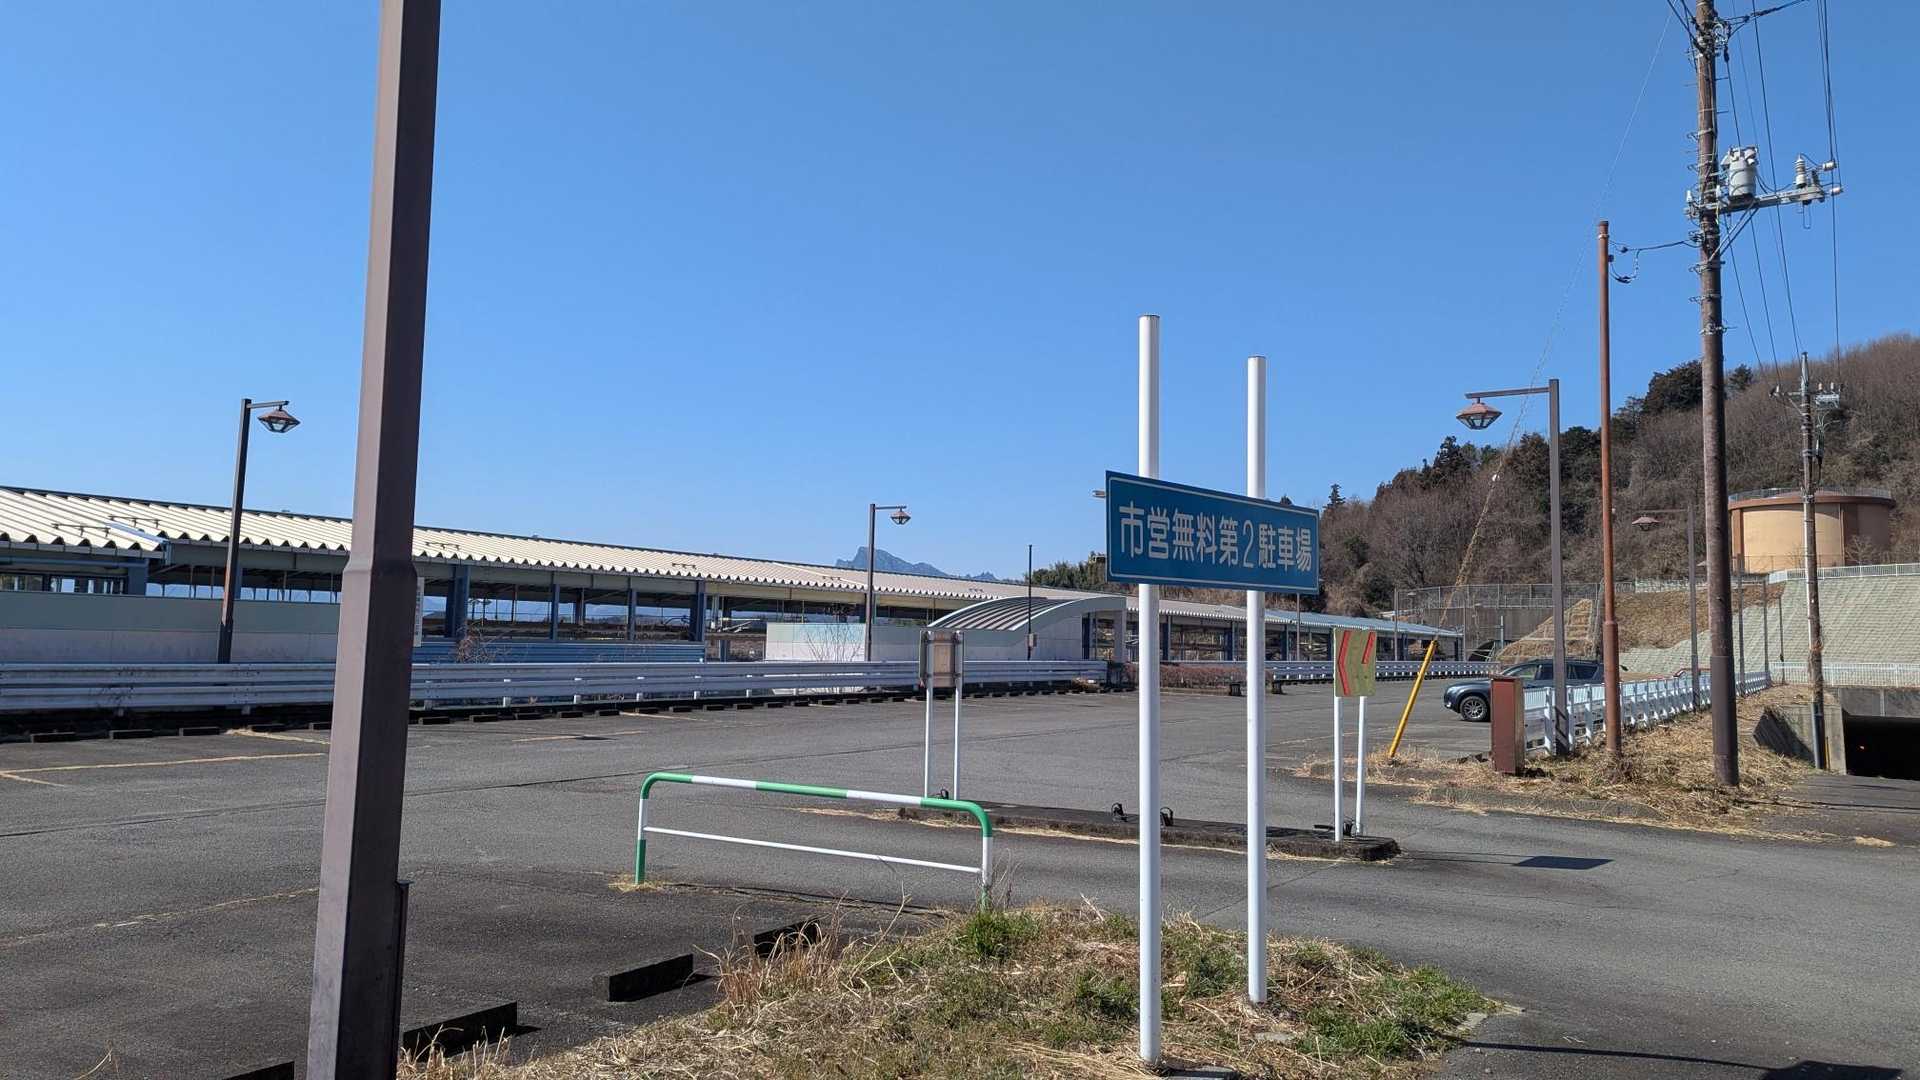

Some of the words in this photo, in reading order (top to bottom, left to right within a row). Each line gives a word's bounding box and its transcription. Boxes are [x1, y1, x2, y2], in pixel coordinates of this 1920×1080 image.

[1119, 500, 1312, 572] 市営無料第2駐車場
